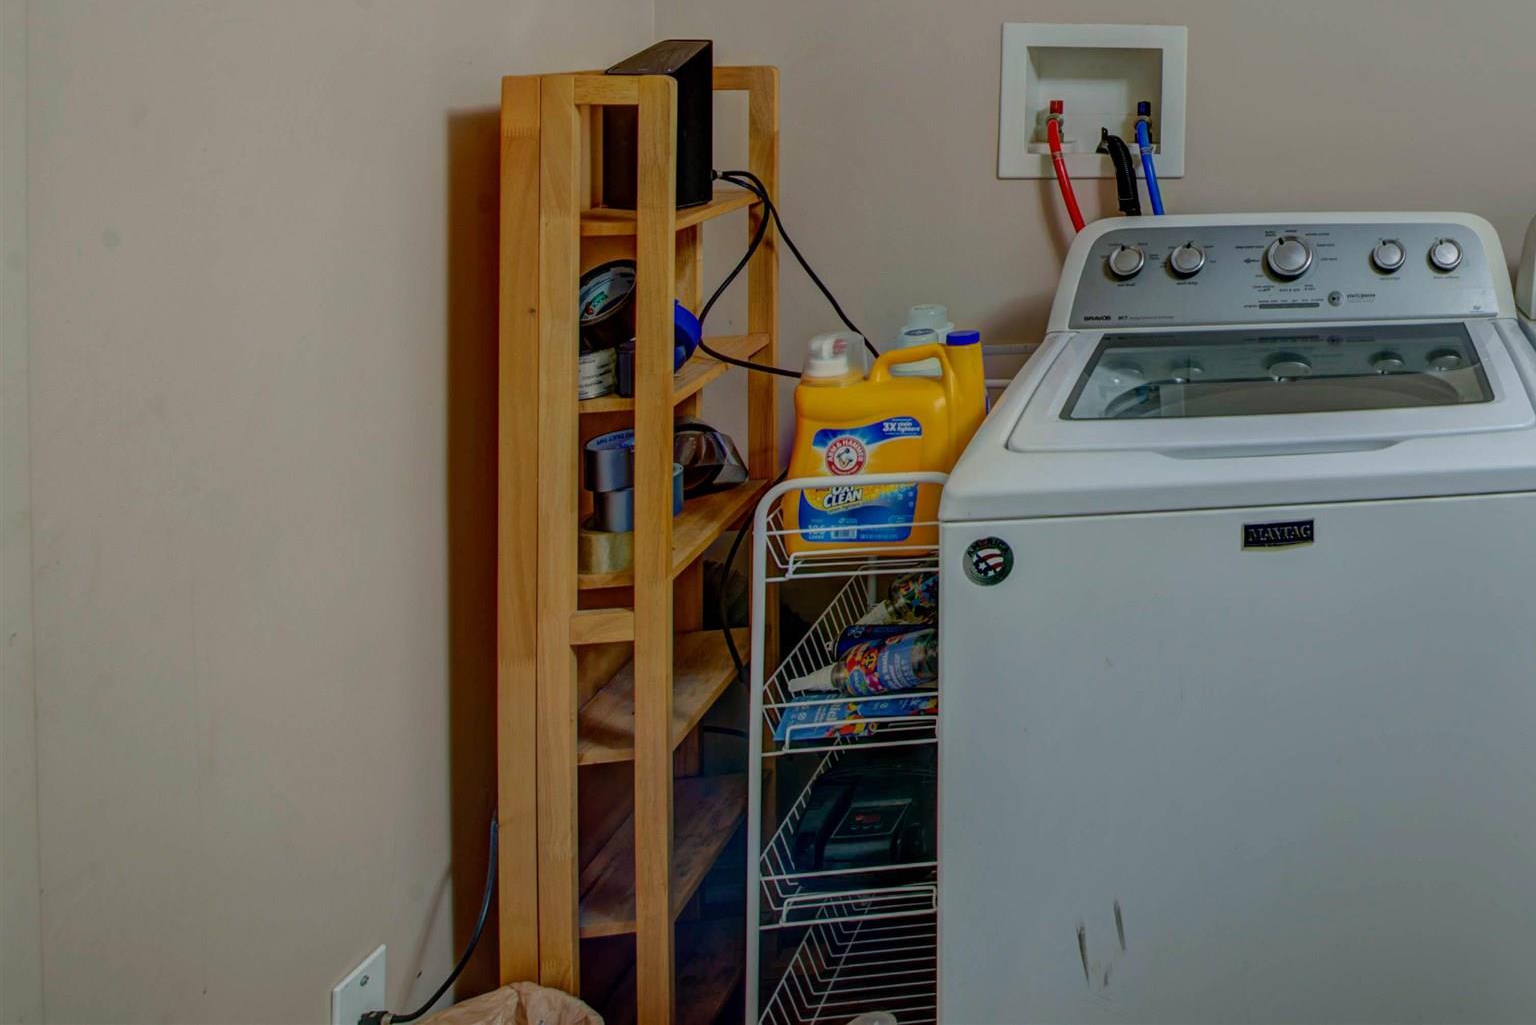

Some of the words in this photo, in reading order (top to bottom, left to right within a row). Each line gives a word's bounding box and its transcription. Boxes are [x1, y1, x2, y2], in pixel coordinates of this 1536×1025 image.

[882, 422, 897, 432] 3X
[823, 489, 862, 507] CLEAN
[1247, 525, 1311, 542] MAYTAG
